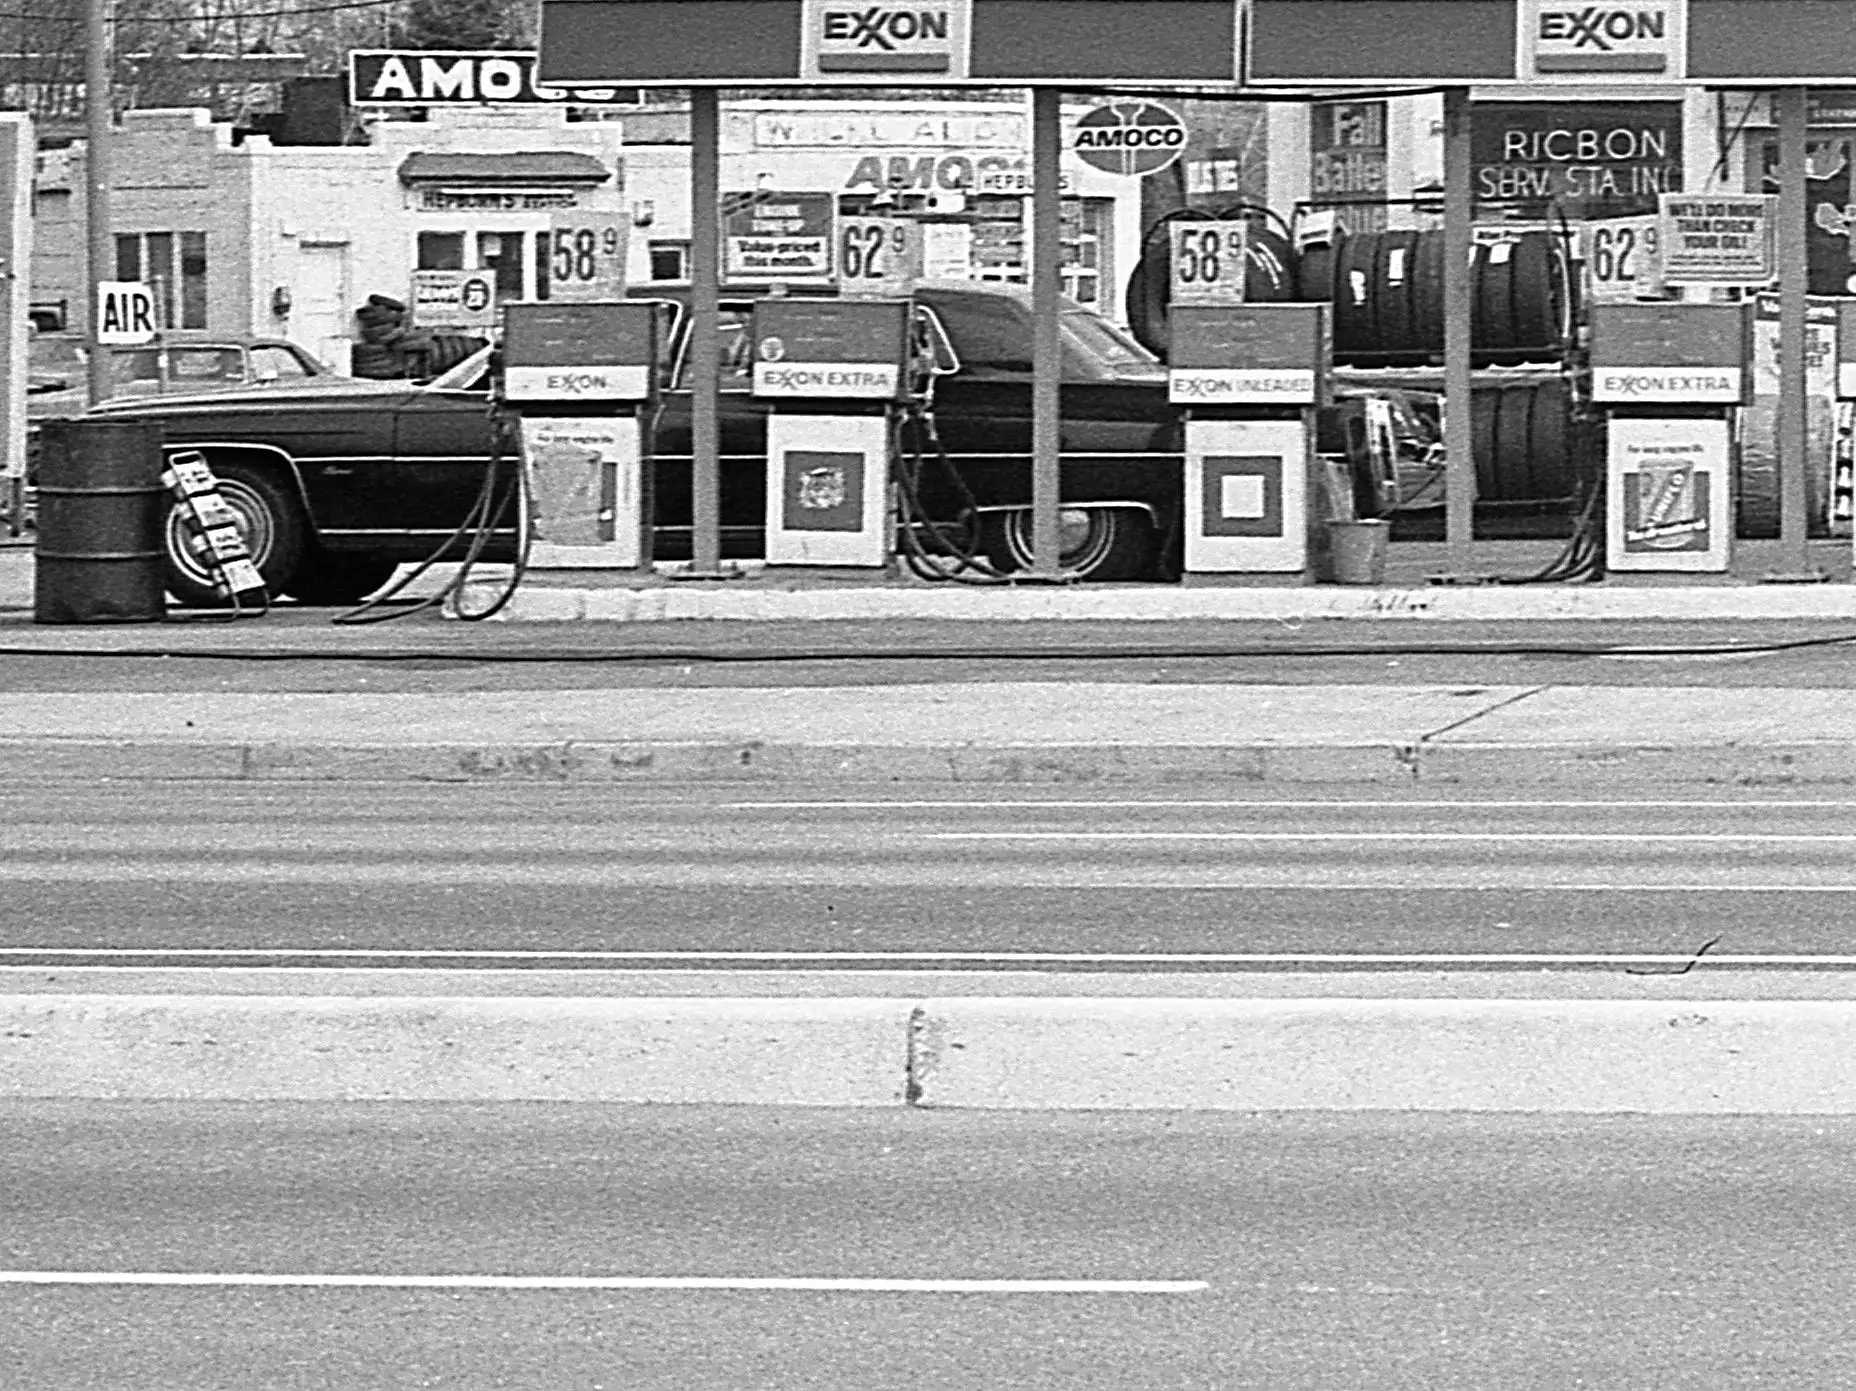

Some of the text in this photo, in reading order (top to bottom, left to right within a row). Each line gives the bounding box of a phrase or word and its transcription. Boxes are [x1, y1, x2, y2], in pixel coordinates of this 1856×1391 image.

[823, 6, 948, 51] EXXON
[1539, 6, 1664, 51] EXXON
[370, 56, 616, 100] AMO
[1074, 128, 1184, 147] AMOCO
[1504, 127, 1666, 160] RICBON
[844, 156, 1026, 190] AMO
[1677, 218, 1755, 233] THAN CHECK
[554, 228, 596, 282] 58
[842, 225, 884, 279] 62
[1179, 229, 1220, 284] 58
[1592, 226, 1636, 283] 62
[102, 292, 153, 333] AIR
[546, 373, 607, 394] EXXON
[763, 368, 889, 391] EXXON EXTRA
[1173, 376, 1233, 397] EXXON
[1604, 374, 1732, 396] EXXON EXTRA
